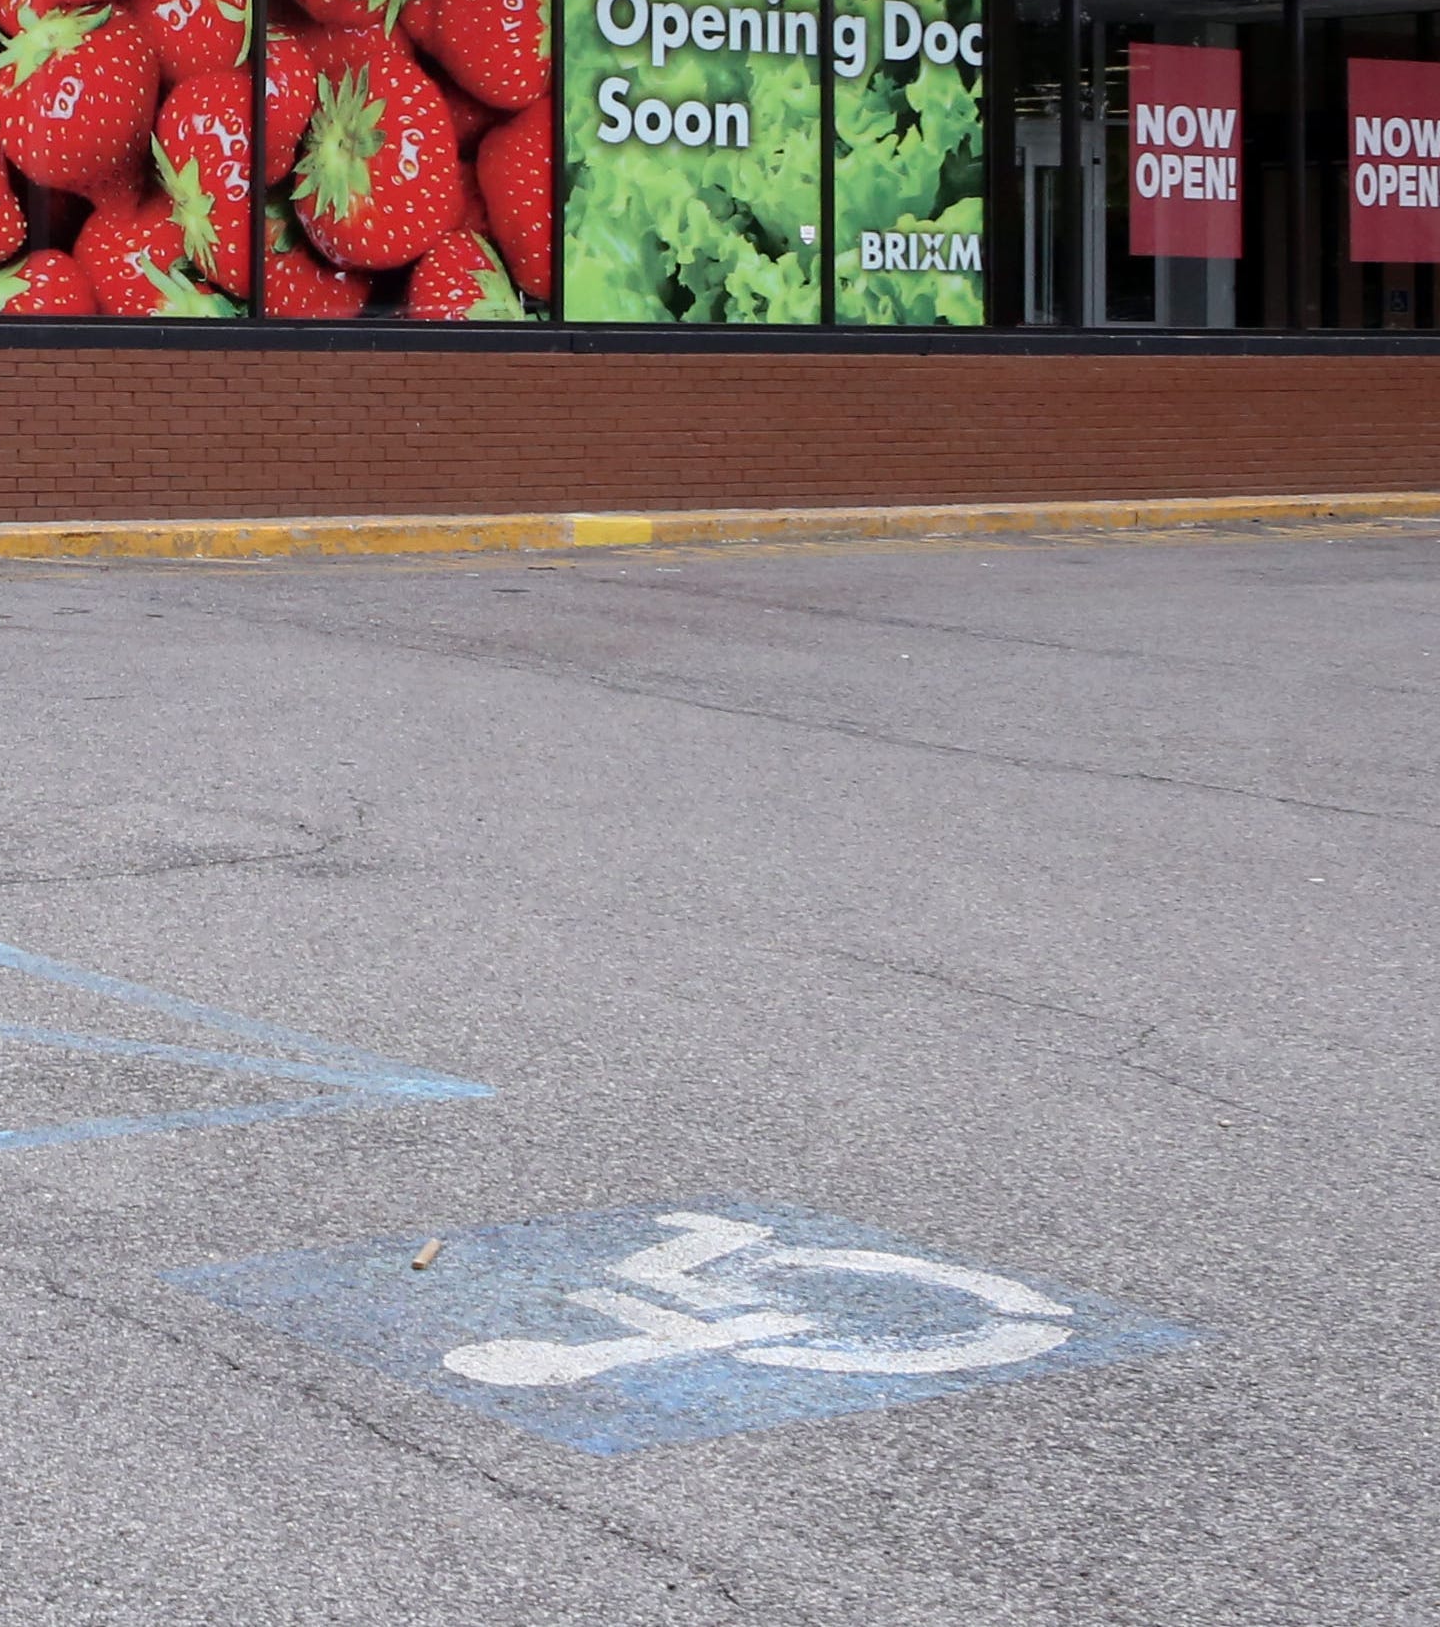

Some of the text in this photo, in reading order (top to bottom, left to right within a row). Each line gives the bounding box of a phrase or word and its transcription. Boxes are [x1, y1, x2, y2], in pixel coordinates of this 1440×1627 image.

[597, 77, 749, 147] Soon
[1136, 104, 1236, 149] NOW
[1136, 153, 1237, 201] OPEN!
[861, 231, 983, 271] BRIXM
